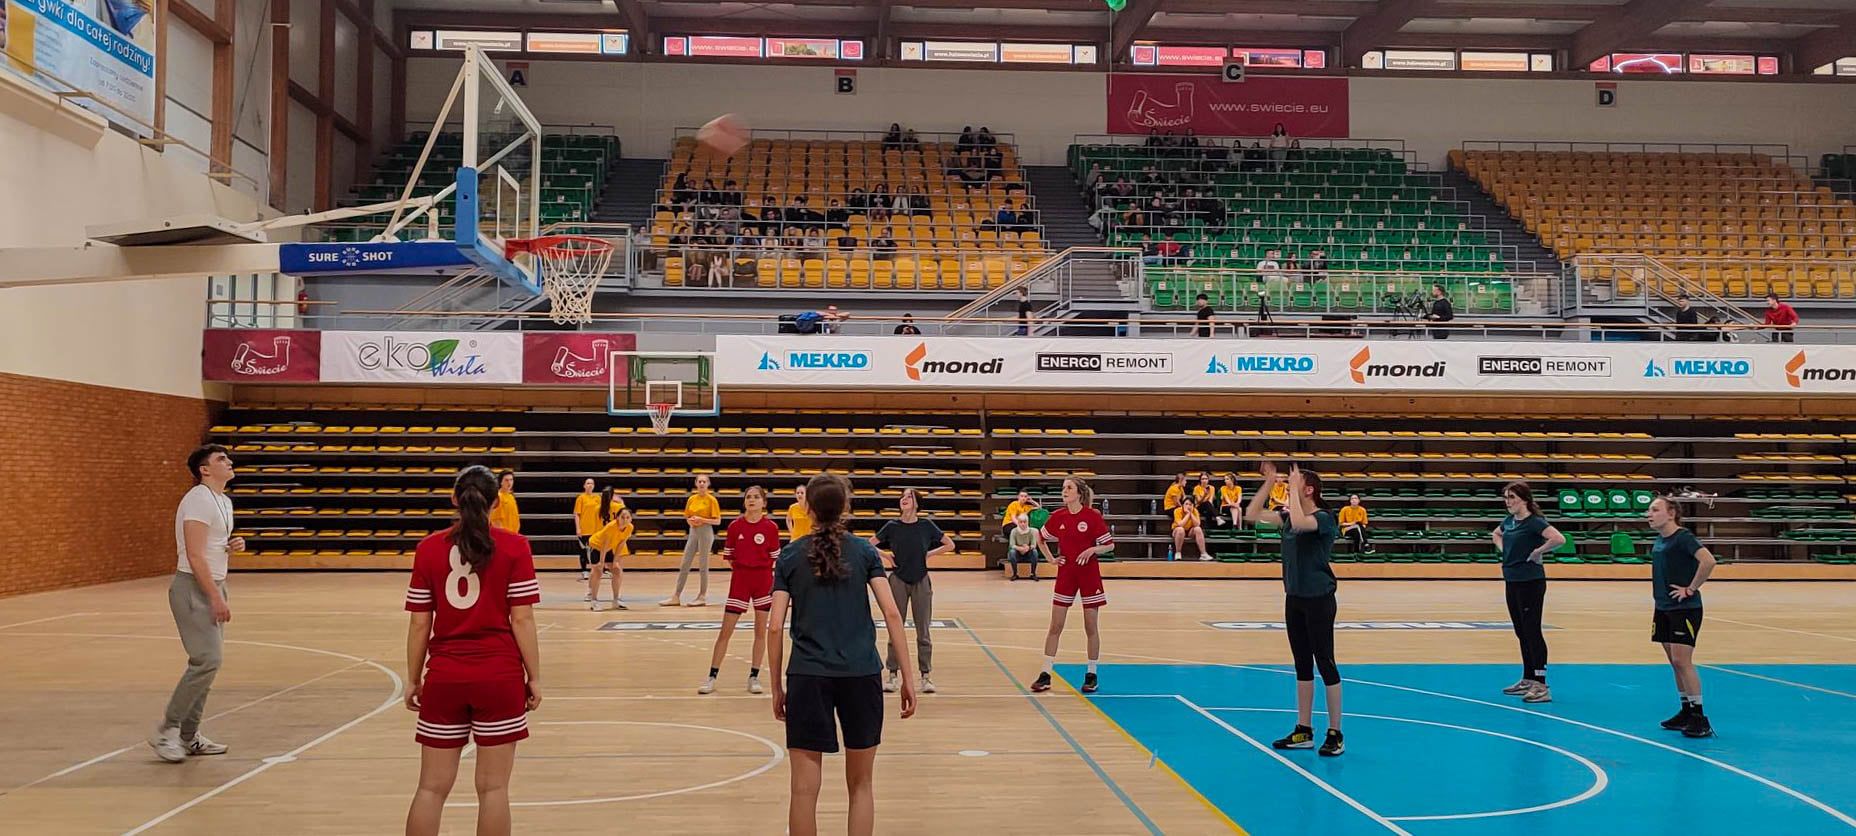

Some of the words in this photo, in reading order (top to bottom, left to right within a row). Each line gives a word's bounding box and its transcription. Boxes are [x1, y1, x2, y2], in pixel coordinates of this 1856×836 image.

[66, 10, 84, 31] dla
[86, 23, 112, 51] całej
[113, 41, 151, 72] rodziny!
[509, 70, 526, 85] A
[1226, 64, 1241, 80] C
[838, 77, 854, 93] B
[1599, 90, 1613, 104] D
[1209, 101, 1329, 114] www.swiecie.eu
[308, 252, 339, 263] SURE
[362, 251, 393, 262] SHOT
[358, 335, 431, 371] eko
[789, 352, 868, 370] MEKRO
[922, 357, 1004, 375] mondi
[1041, 356, 1099, 369] ENERGO
[1106, 357, 1167, 369] REMONT
[1237, 356, 1313, 372] MEKRO
[1367, 361, 1446, 377] mondi
[1482, 360, 1540, 372] ENERGO
[1546, 361, 1606, 372] REMONT
[1674, 359, 1749, 375] MEKRO
[445, 545, 481, 610] 8
